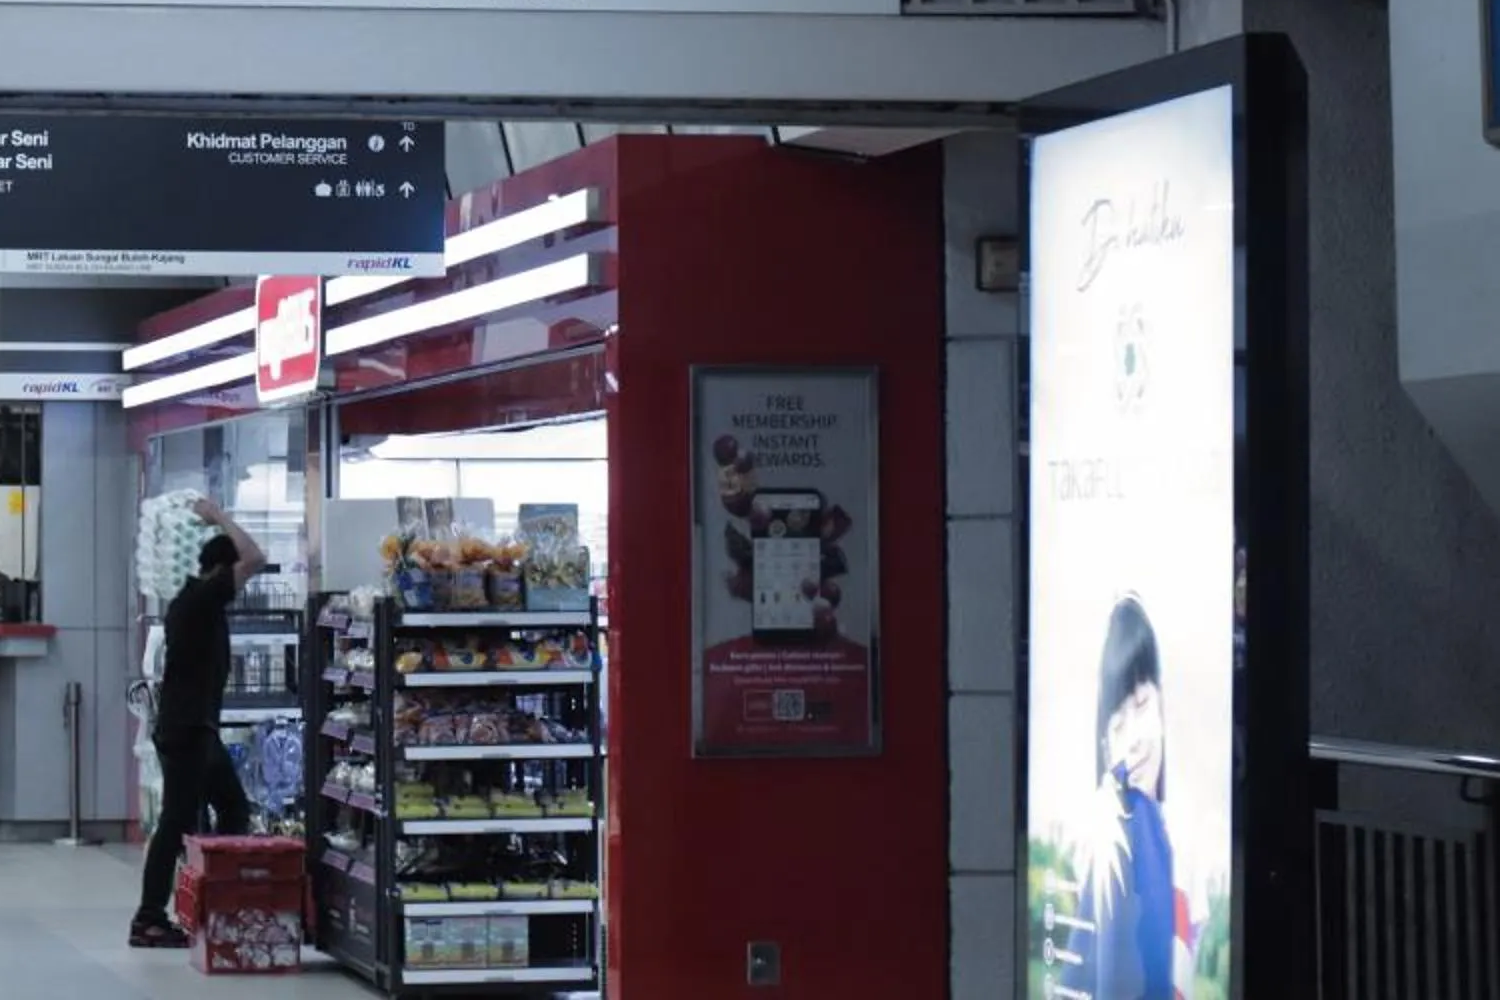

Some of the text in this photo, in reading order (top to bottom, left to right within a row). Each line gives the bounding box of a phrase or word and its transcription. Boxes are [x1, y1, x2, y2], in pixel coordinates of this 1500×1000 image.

[11, 130, 49, 147] Seni
[187, 131, 348, 153] Khidmat Pelanggan
[15, 154, 53, 170] Seni
[228, 152, 348, 166] CUSTOMER SERVICE
[765, 394, 805, 411] FREE
[753, 433, 820, 449] INSTANT
